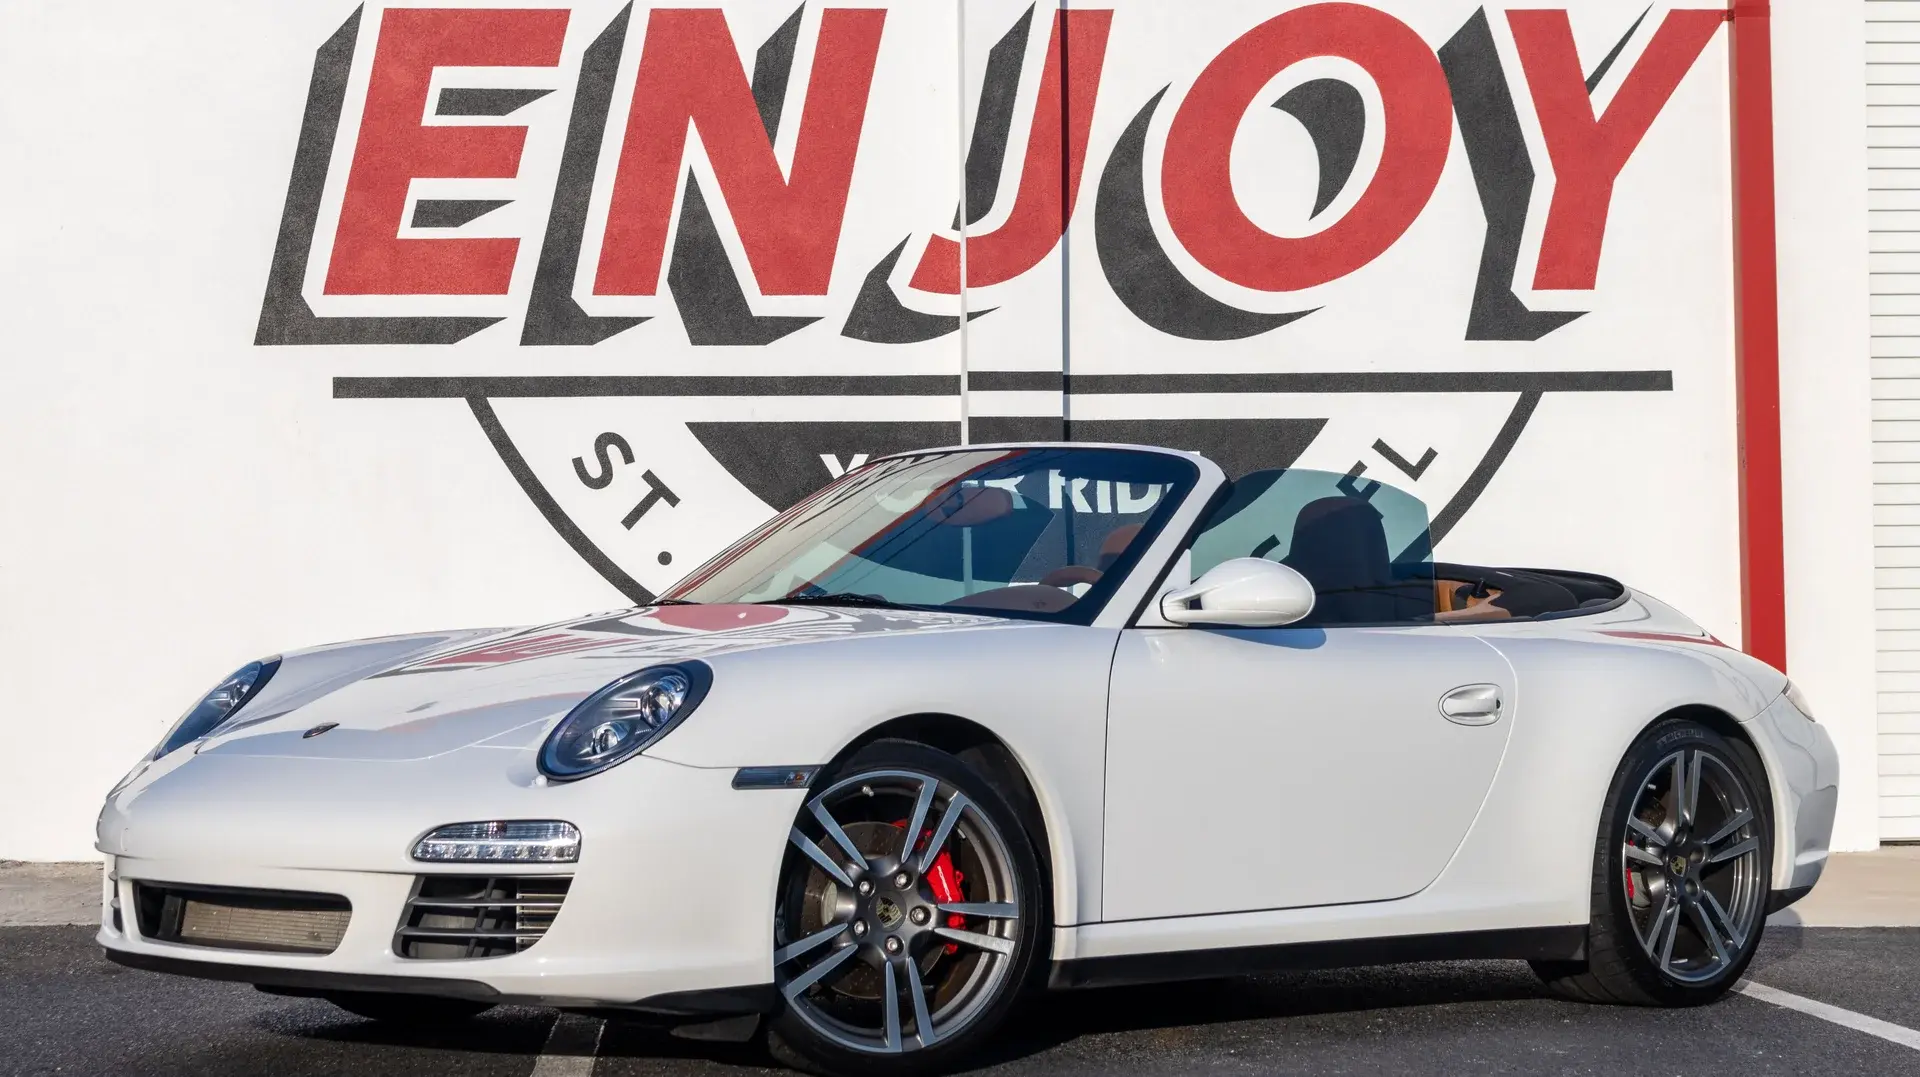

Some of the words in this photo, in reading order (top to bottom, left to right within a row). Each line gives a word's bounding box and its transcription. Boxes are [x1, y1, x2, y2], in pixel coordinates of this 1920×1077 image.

[254, 0, 1728, 345] ENJOY
[571, 431, 682, 567] ST.
[1048, 468, 1176, 514] RID
